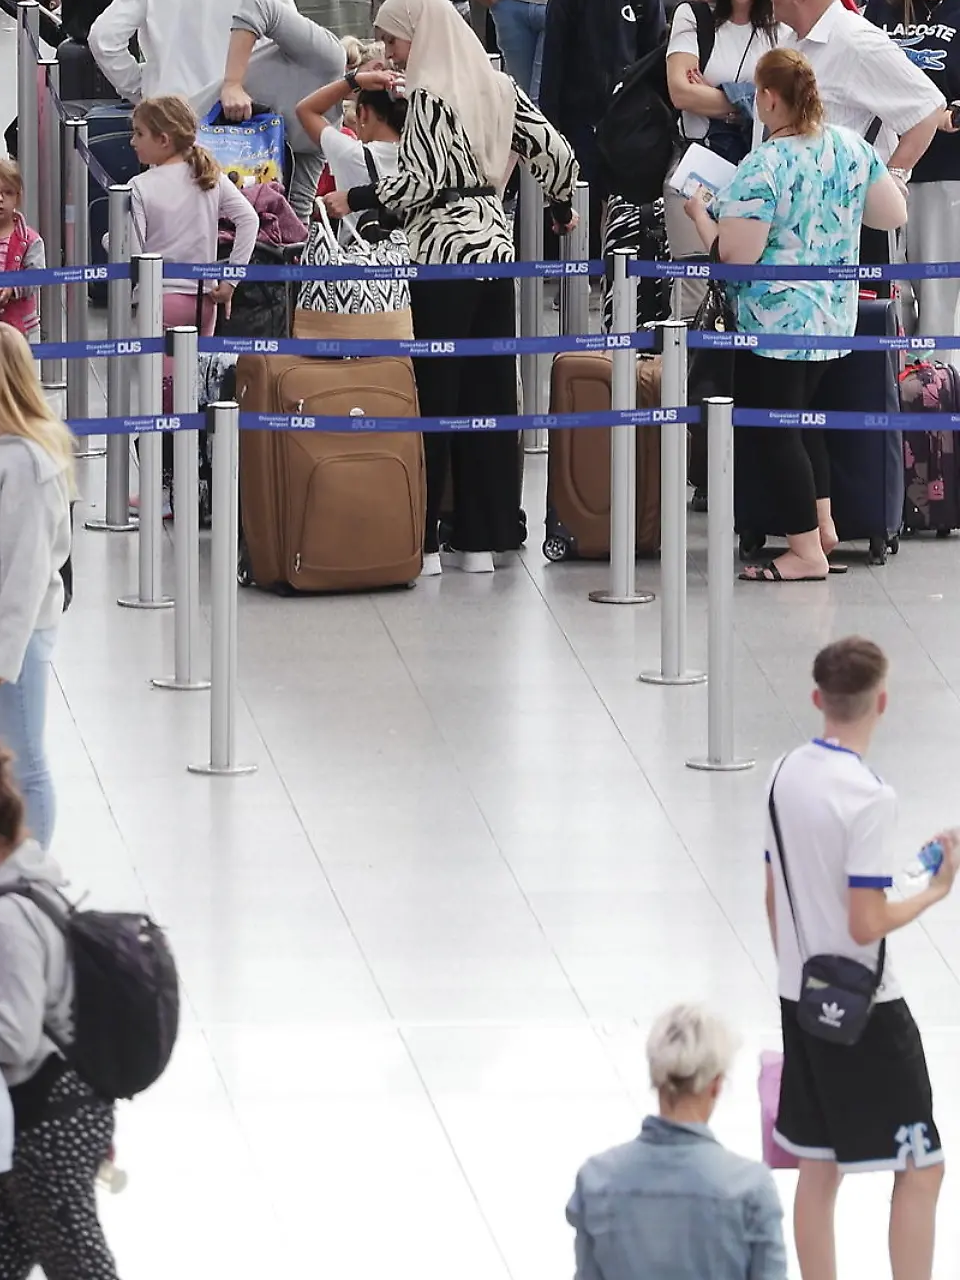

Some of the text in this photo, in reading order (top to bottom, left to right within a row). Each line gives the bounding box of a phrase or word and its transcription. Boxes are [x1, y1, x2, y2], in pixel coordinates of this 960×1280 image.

[882, 22, 957, 42] LACOSTE
[84, 268, 108, 279] DUS
[223, 267, 247, 278] DUS
[395, 267, 417, 278] DUS
[566, 263, 589, 273] DUS
[687, 266, 710, 276] DUS
[859, 268, 882, 278] DUS
[255, 341, 278, 351] DUS
[607, 336, 631, 347] DUS
[735, 336, 758, 346] DUS
[912, 338, 935, 348] DUS
[118, 342, 142, 353] DUS
[431, 342, 455, 353] DUS
[653, 410, 677, 421] DUS
[801, 413, 826, 425] DUS
[156, 418, 180, 429] DUS
[291, 417, 315, 428] DUS
[472, 418, 496, 429] DUS
